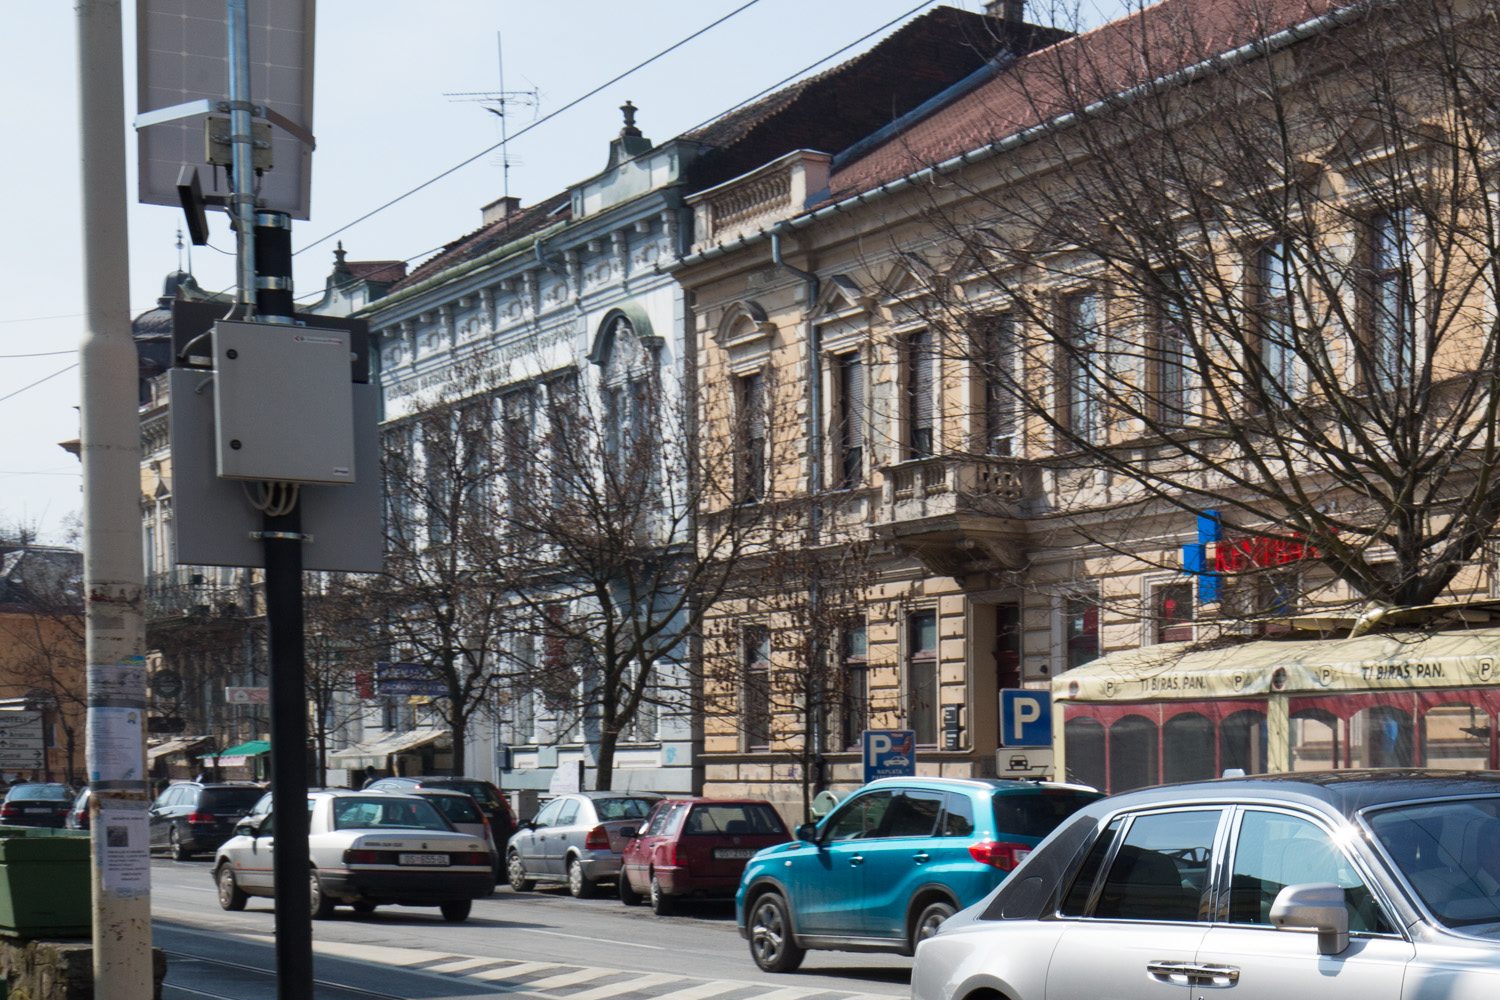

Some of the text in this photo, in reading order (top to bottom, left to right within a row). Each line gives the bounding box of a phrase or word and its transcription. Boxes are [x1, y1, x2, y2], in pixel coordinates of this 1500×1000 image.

[1416, 663, 1445, 679] PAN.
[1014, 697, 1041, 740] P
[870, 734, 892, 767] P
